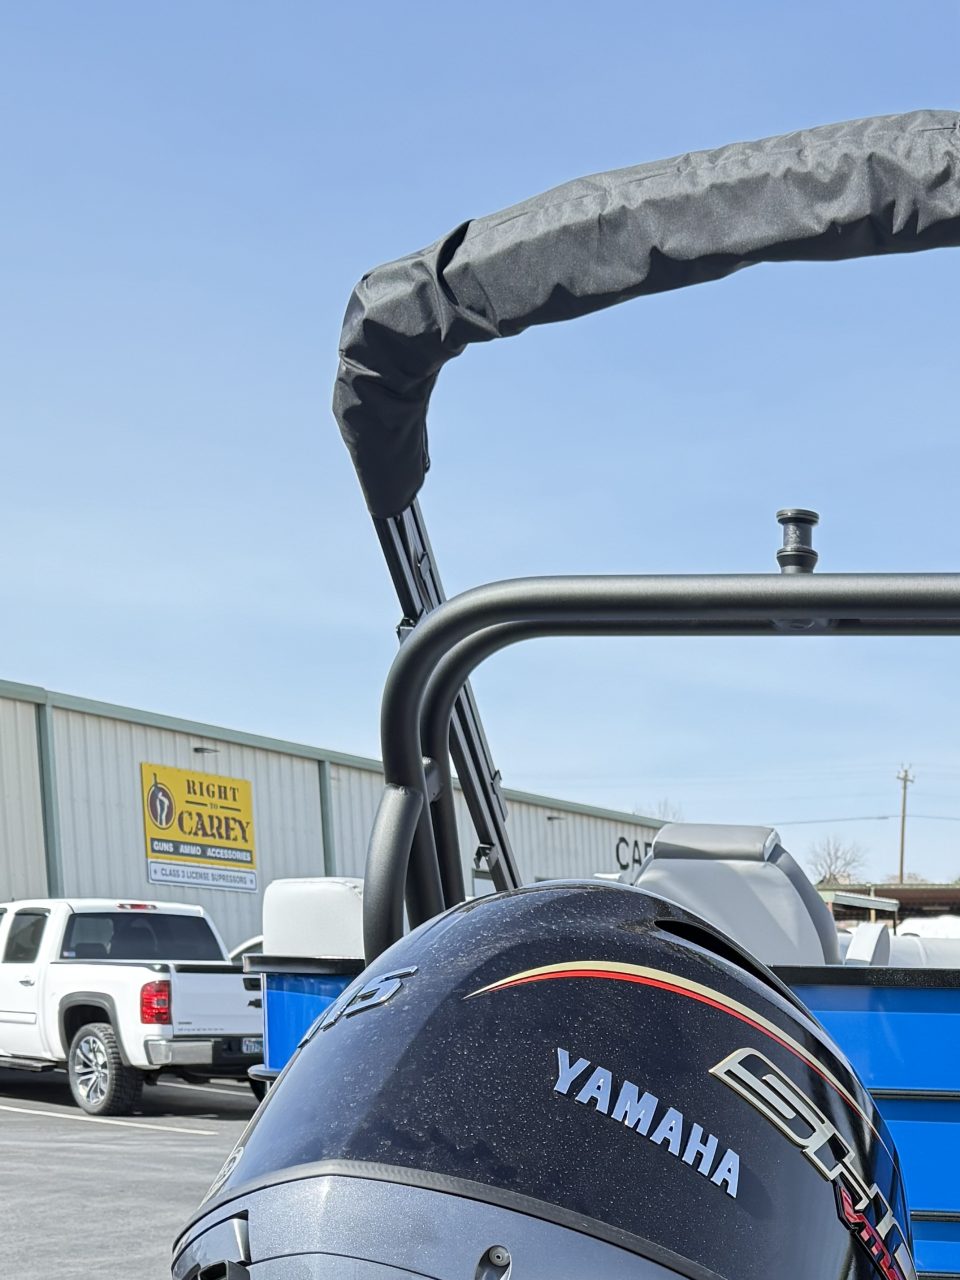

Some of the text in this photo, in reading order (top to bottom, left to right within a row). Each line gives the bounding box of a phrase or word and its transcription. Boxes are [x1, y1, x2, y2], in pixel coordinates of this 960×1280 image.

[186, 779, 240, 802] RIGHT
[178, 810, 251, 843] CAREY
[153, 840, 251, 861] GUNS AMMO ACCESSORIES
[160, 867, 180, 879] CLASS
[186, 869, 210, 881] LICENSE
[553, 1047, 740, 1198] YAMAHA
